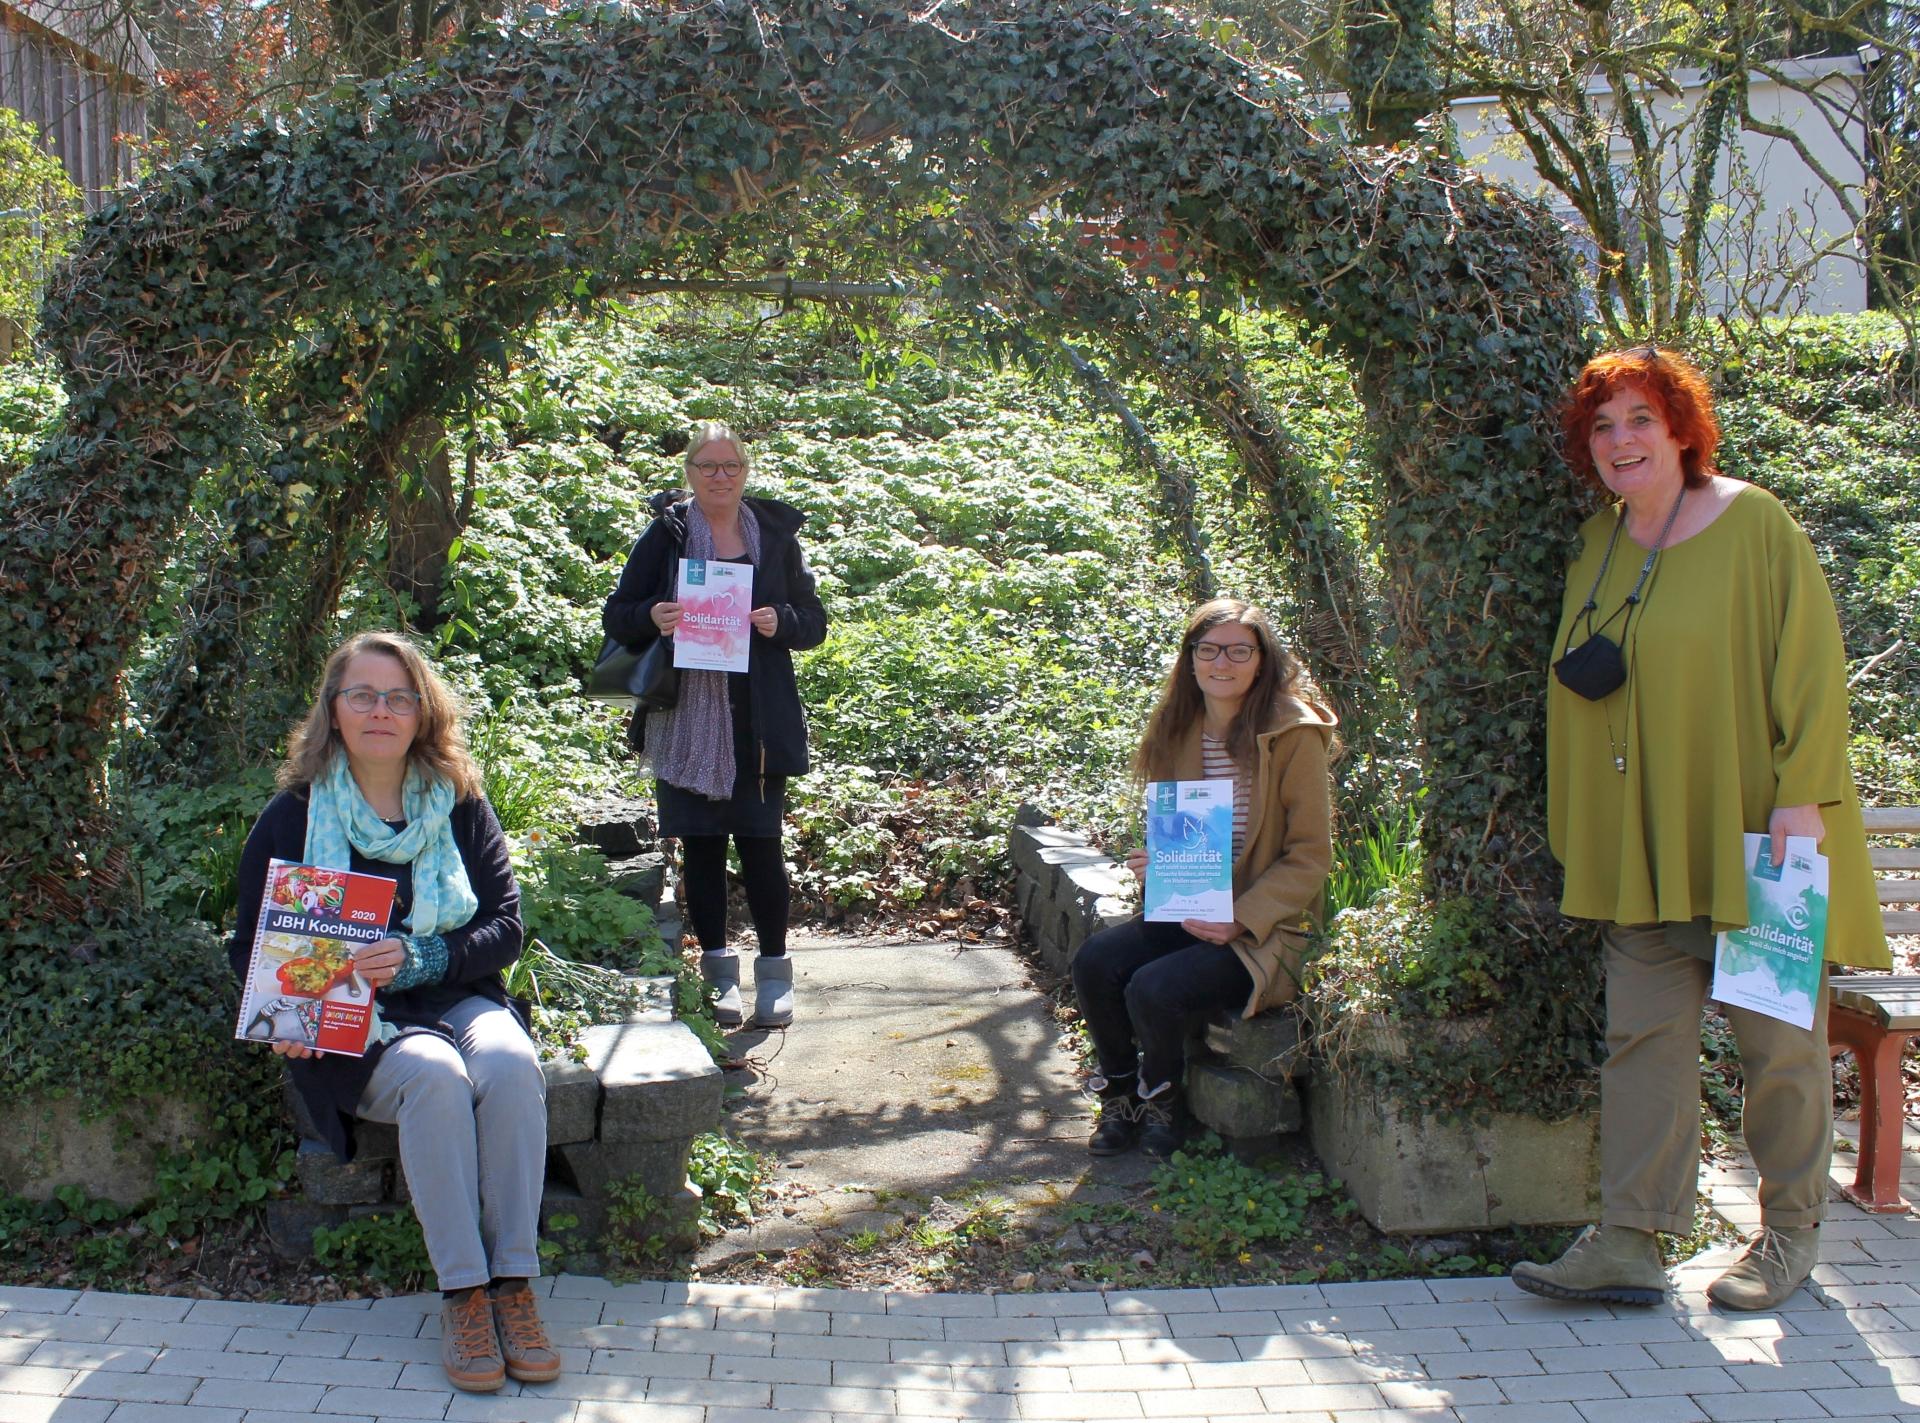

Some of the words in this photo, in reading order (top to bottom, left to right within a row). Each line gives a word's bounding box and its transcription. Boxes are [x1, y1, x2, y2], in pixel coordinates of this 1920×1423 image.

[683, 612, 742, 626] Solidarität
[351, 909, 376, 921] 2020
[272, 915, 305, 930] JBH
[309, 919, 384, 941] Kochbuch
